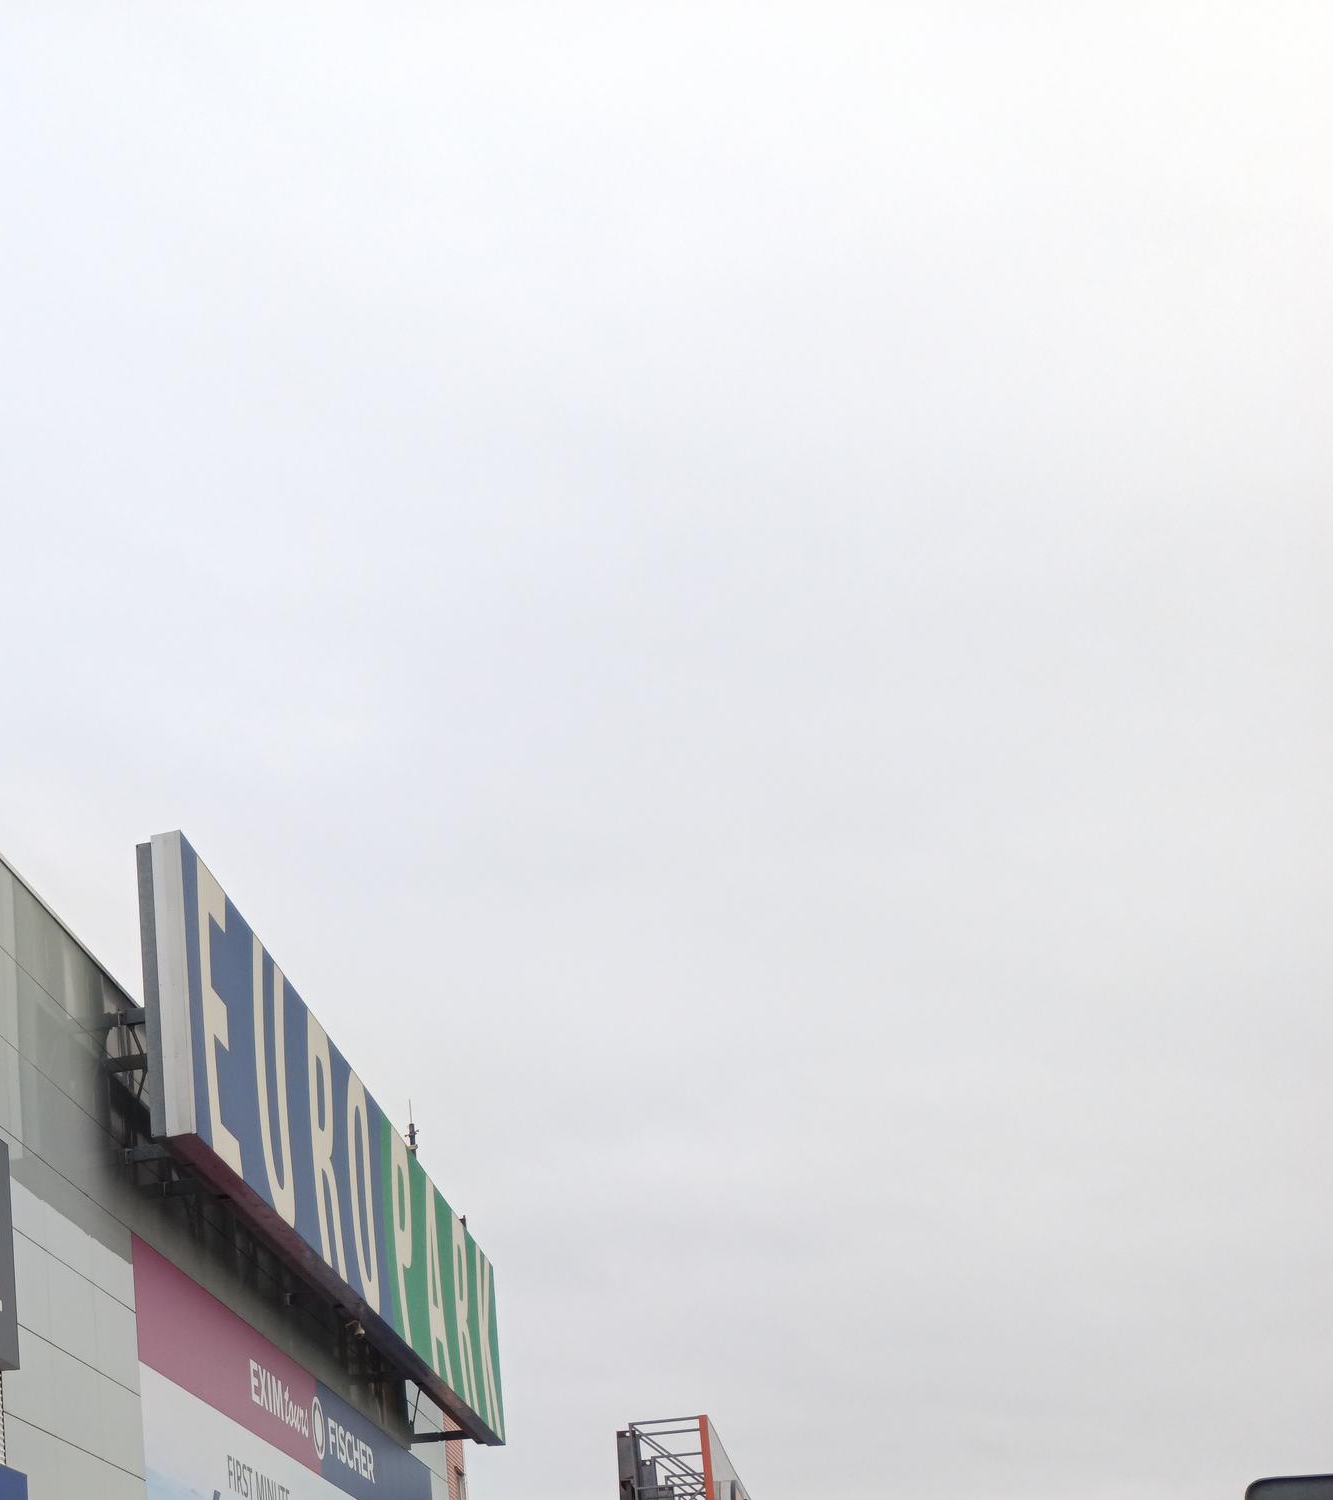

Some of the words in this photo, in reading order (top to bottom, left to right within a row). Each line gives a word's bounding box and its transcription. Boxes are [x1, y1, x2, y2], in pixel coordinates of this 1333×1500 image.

[196, 855, 501, 1442] EUROPARK
[227, 1455, 253, 1500] FIRST
[328, 1417, 376, 1484] FISCHER
